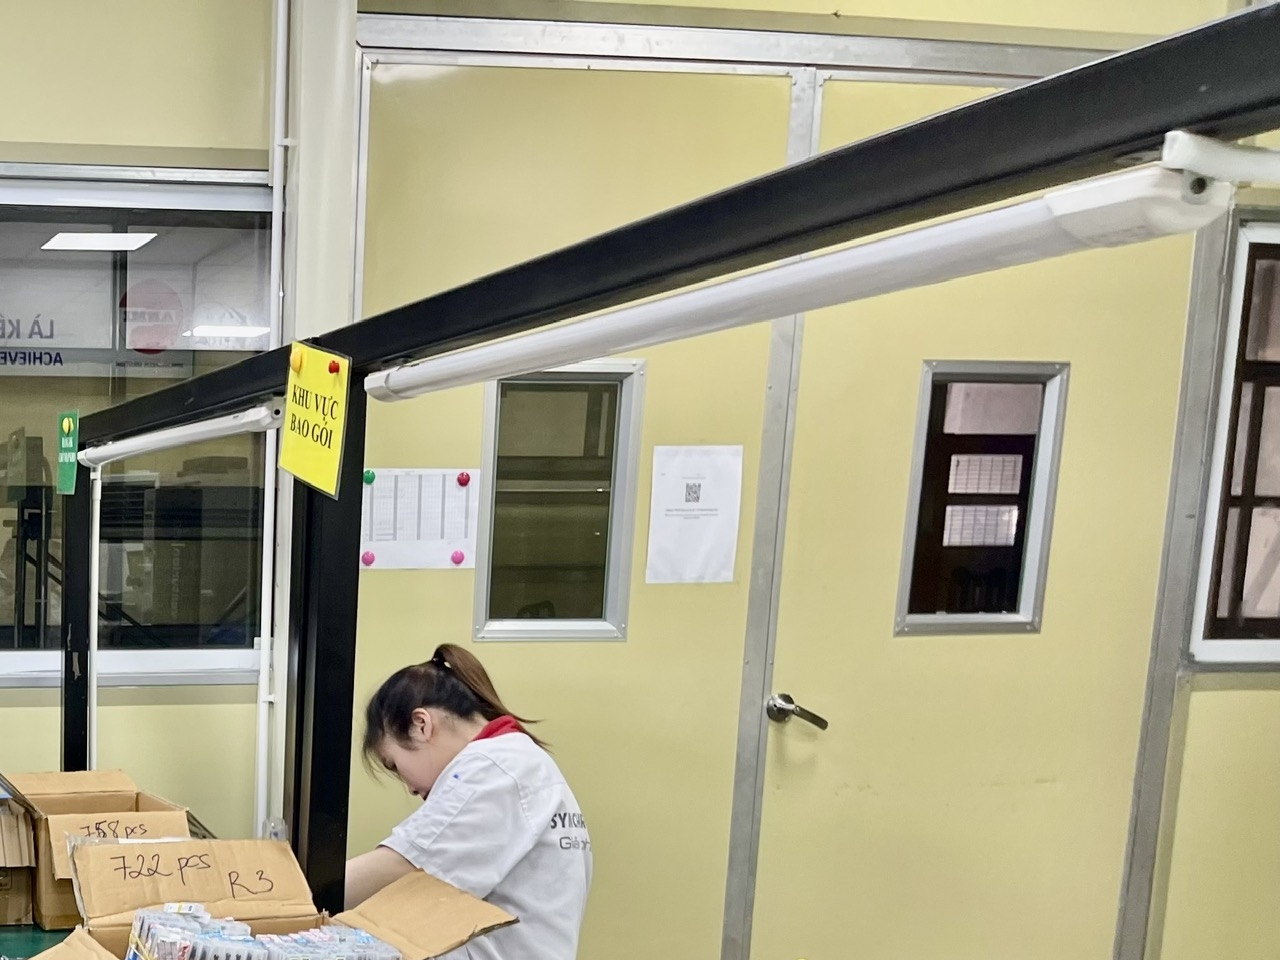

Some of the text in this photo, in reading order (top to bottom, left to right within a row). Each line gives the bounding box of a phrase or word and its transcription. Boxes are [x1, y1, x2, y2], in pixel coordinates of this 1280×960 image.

[292, 384, 339, 421] KHU VỰC
[290, 412, 333, 449] BAO GÓI
[124, 823, 148, 839] pcs
[110, 853, 173, 881] 722
[177, 853, 212, 886] pcs
